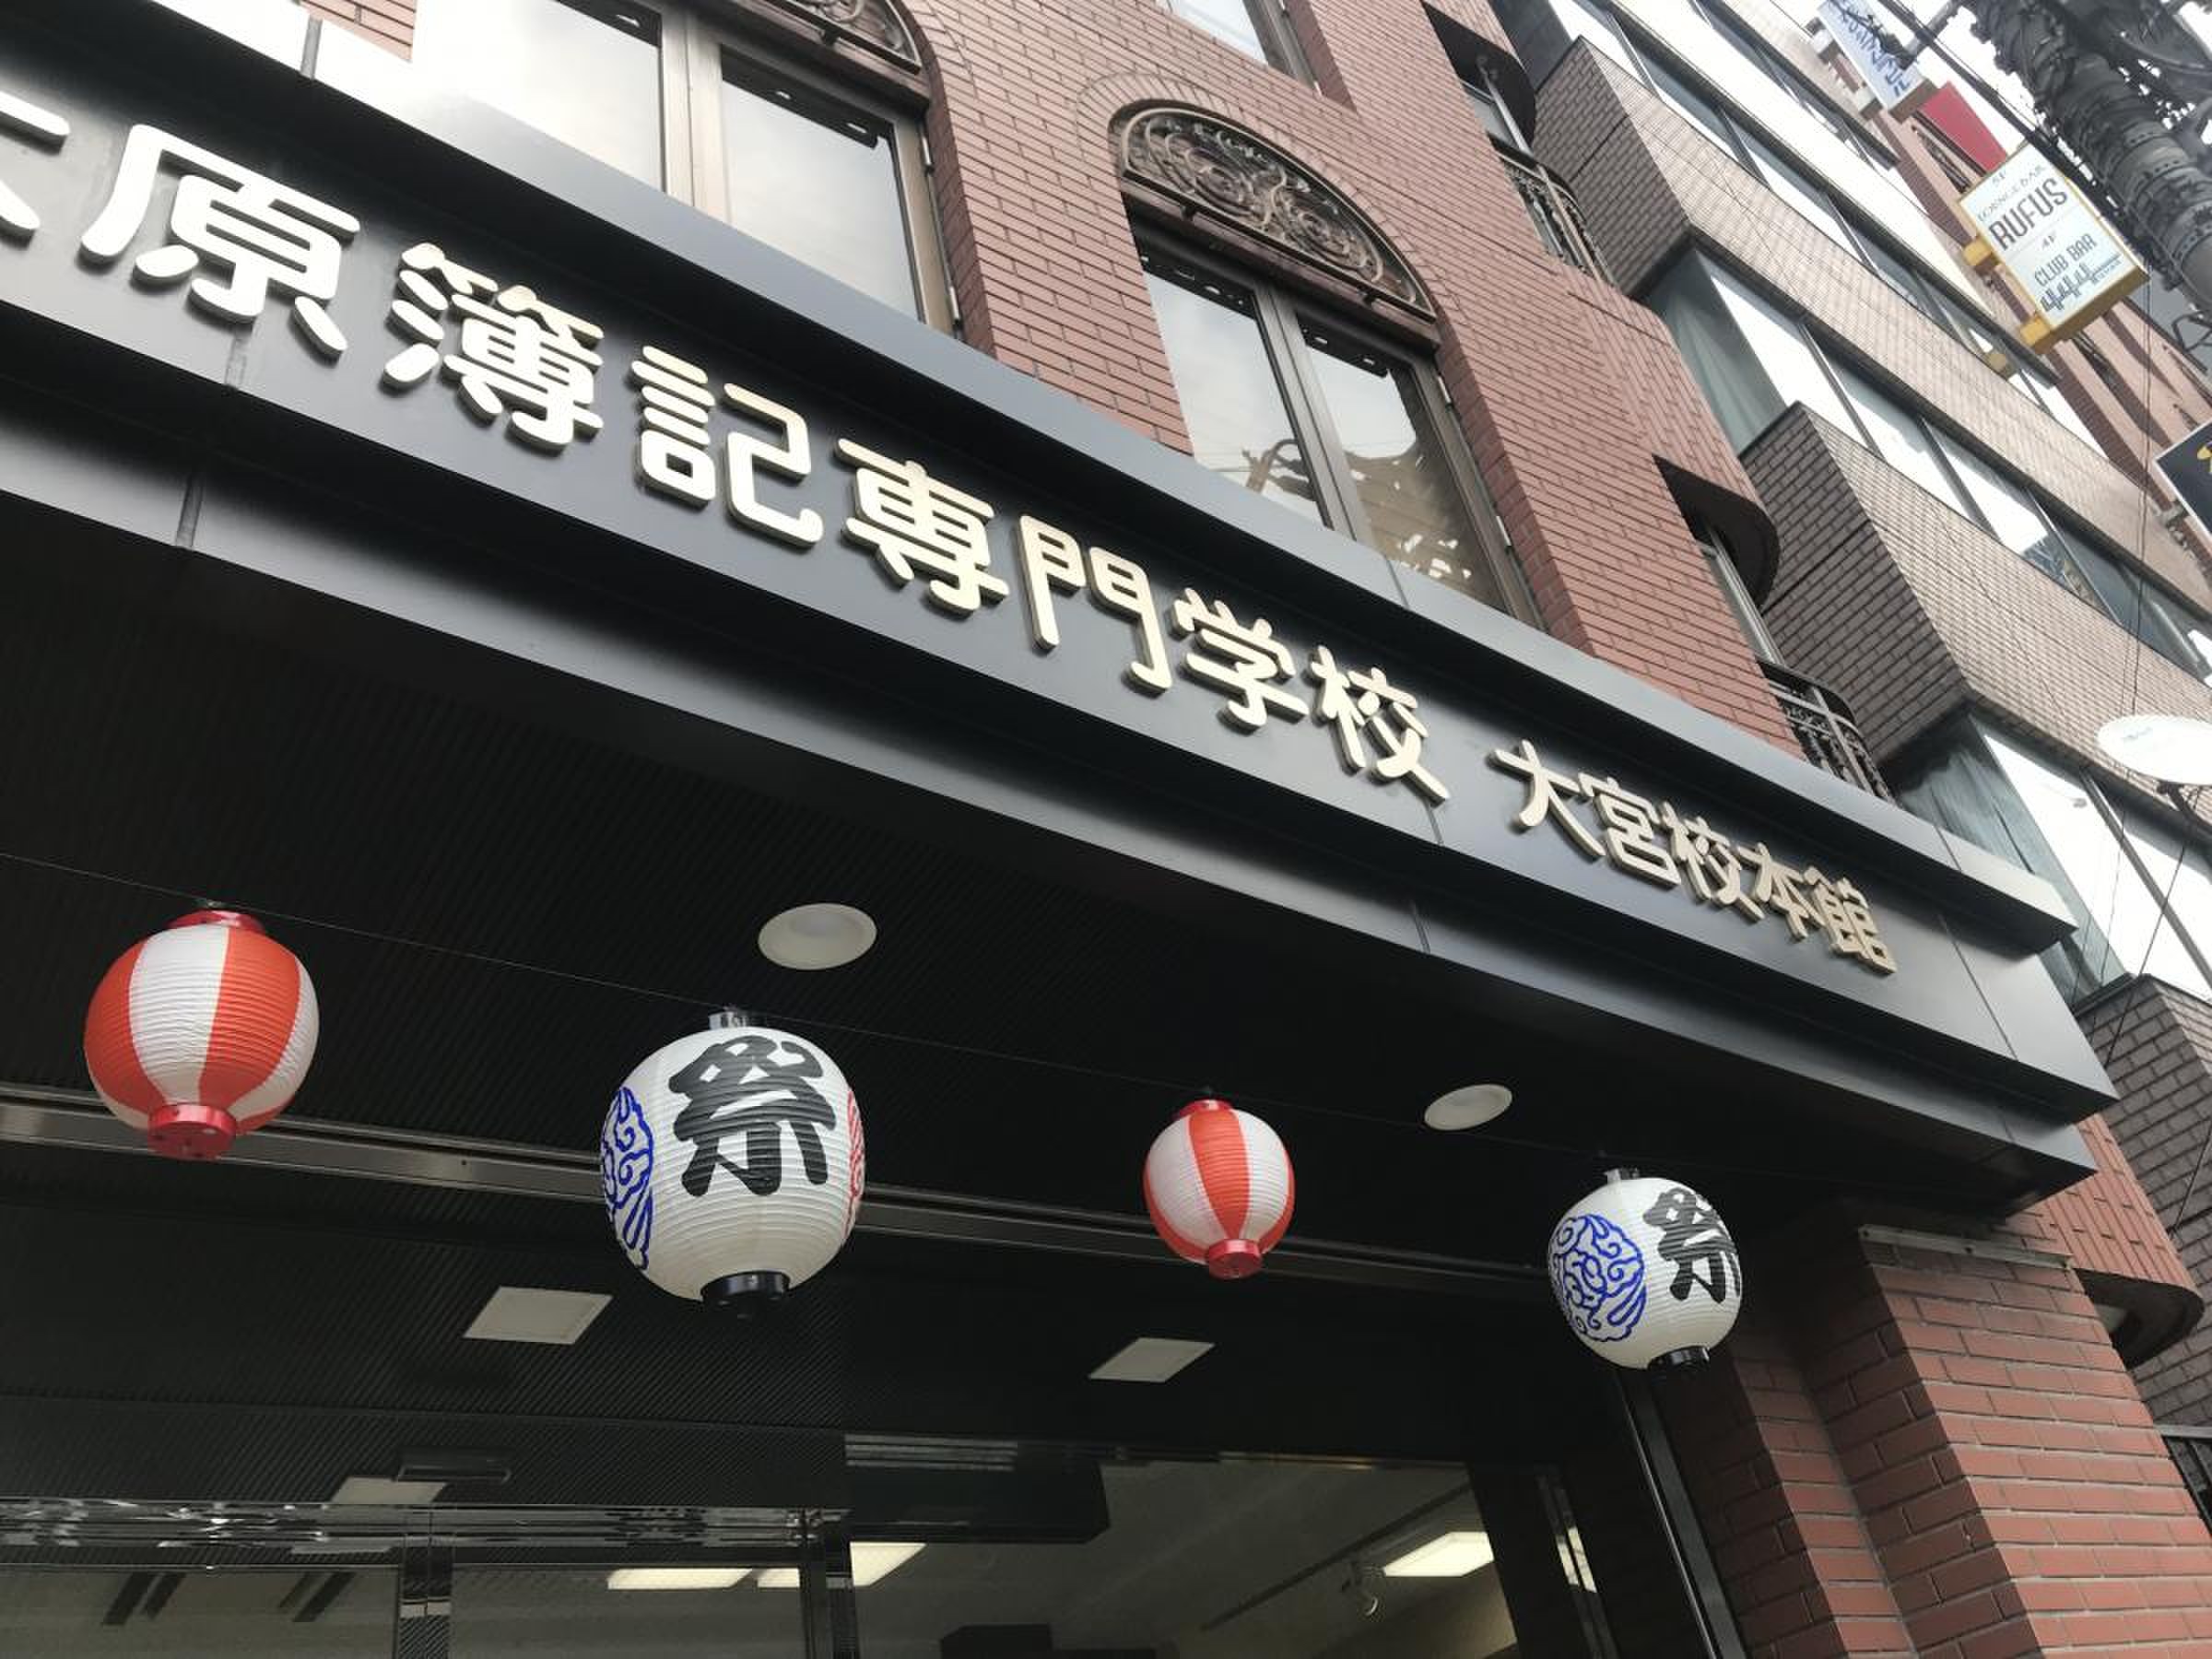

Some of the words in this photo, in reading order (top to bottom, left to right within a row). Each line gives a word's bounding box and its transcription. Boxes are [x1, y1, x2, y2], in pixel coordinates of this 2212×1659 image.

[1988, 177, 2068, 251] RUFUS
[2034, 253, 2069, 288] CLUB
[2066, 233, 2098, 262] BAR
[0, 90, 1450, 804] 原簿記専門学校
[1488, 738, 1897, 975] 大宮校本館
[668, 1034, 837, 1197] 祭
[1642, 1187, 1740, 1304] 祭
